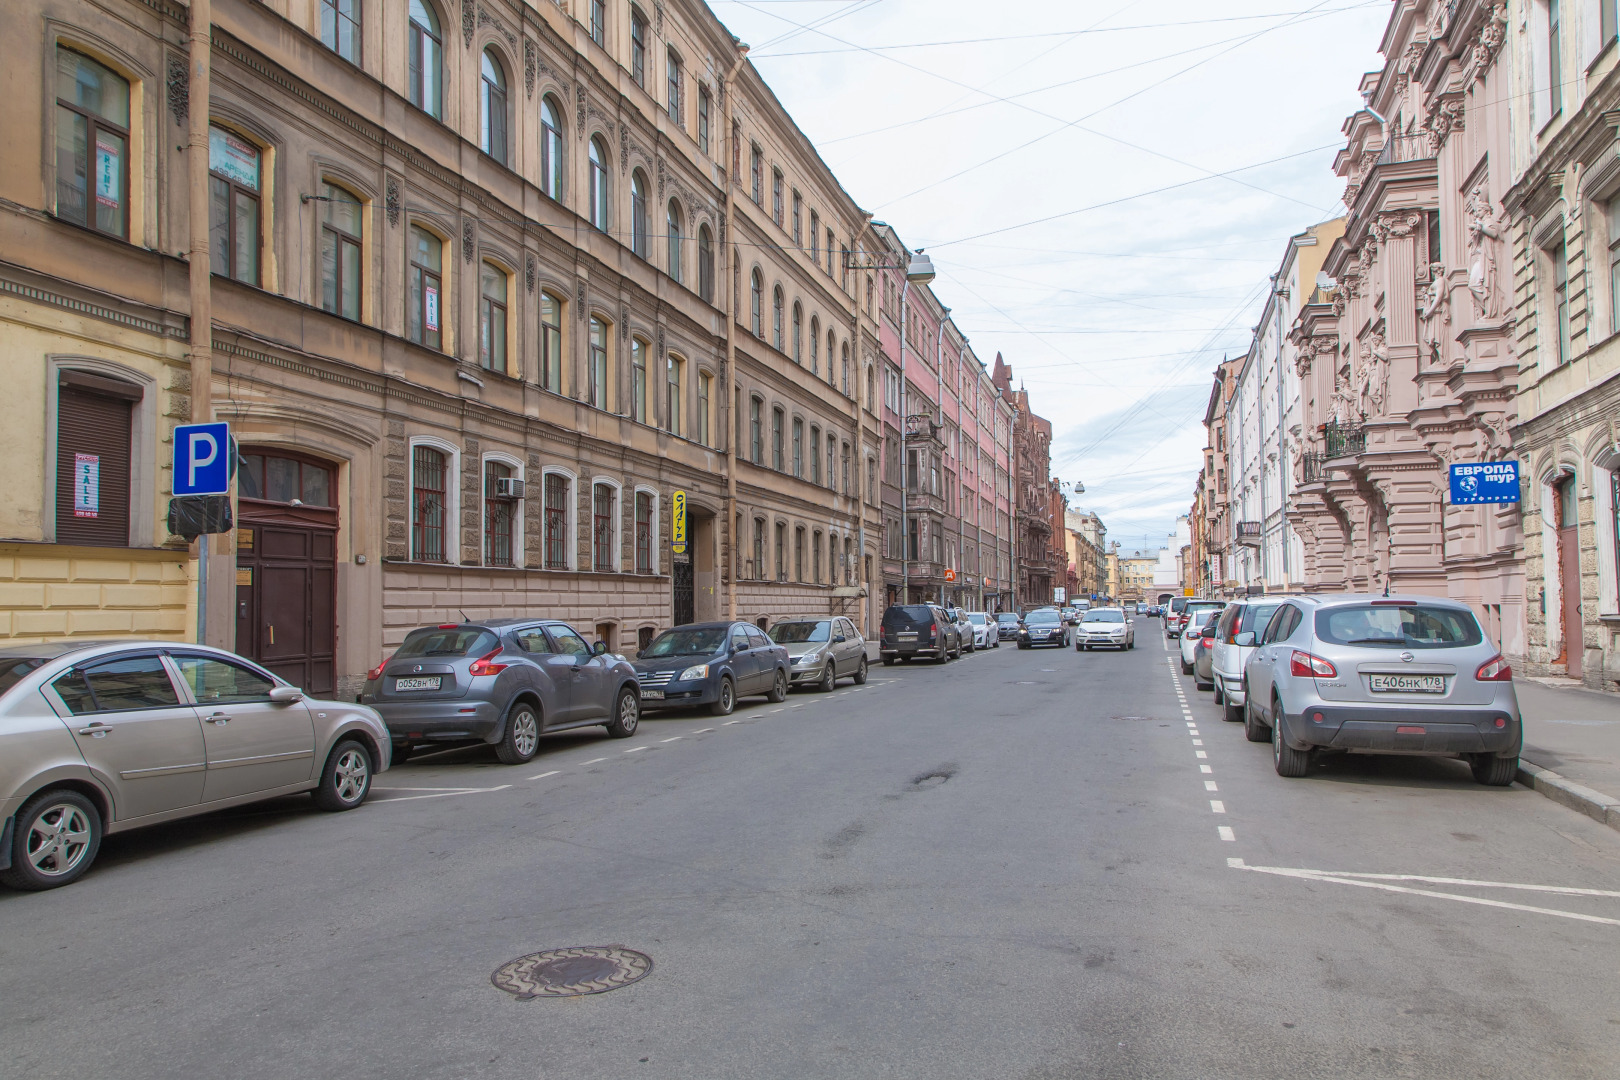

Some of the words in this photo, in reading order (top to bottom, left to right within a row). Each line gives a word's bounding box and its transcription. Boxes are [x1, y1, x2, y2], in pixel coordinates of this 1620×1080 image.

[224, 162, 255, 182] АРЕНДА
[189, 432, 218, 487] P
[1455, 464, 1515, 476] ЕВРОПА
[1485, 474, 1515, 483] тур
[429, 677, 439, 685] 178
[1423, 677, 1441, 686] 178
